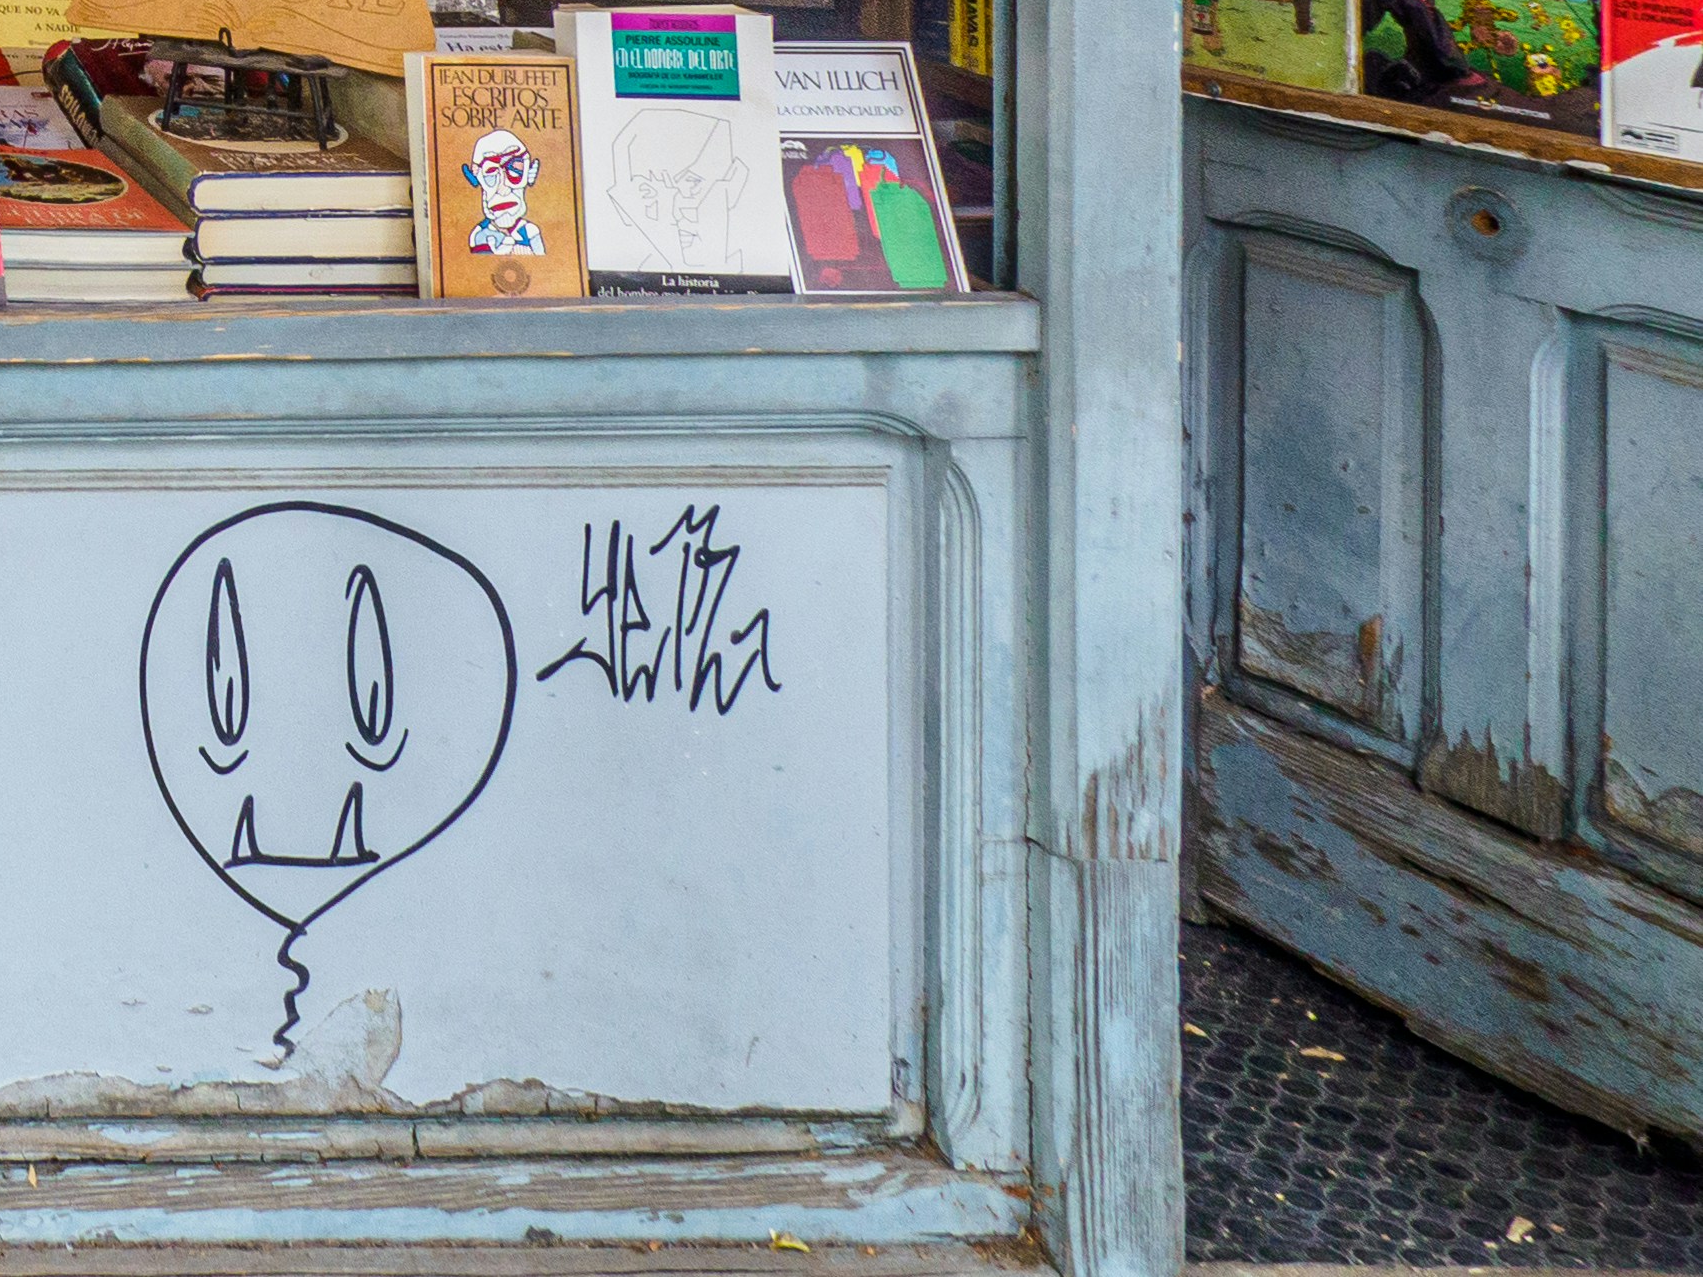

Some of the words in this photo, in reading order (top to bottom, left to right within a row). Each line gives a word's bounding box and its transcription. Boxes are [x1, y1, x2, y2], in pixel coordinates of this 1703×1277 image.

[625, 33, 661, 46] PIERRE
[663, 35, 721, 47] ASSOULINE
[775, 68, 821, 92] VAN
[825, 70, 902, 92] ILLICH
[452, 87, 549, 109] ESCRITOS
[441, 107, 500, 130] SOBRE
[503, 108, 564, 130] ARTE
[661, 274, 676, 287] La
[679, 275, 720, 288] historia
